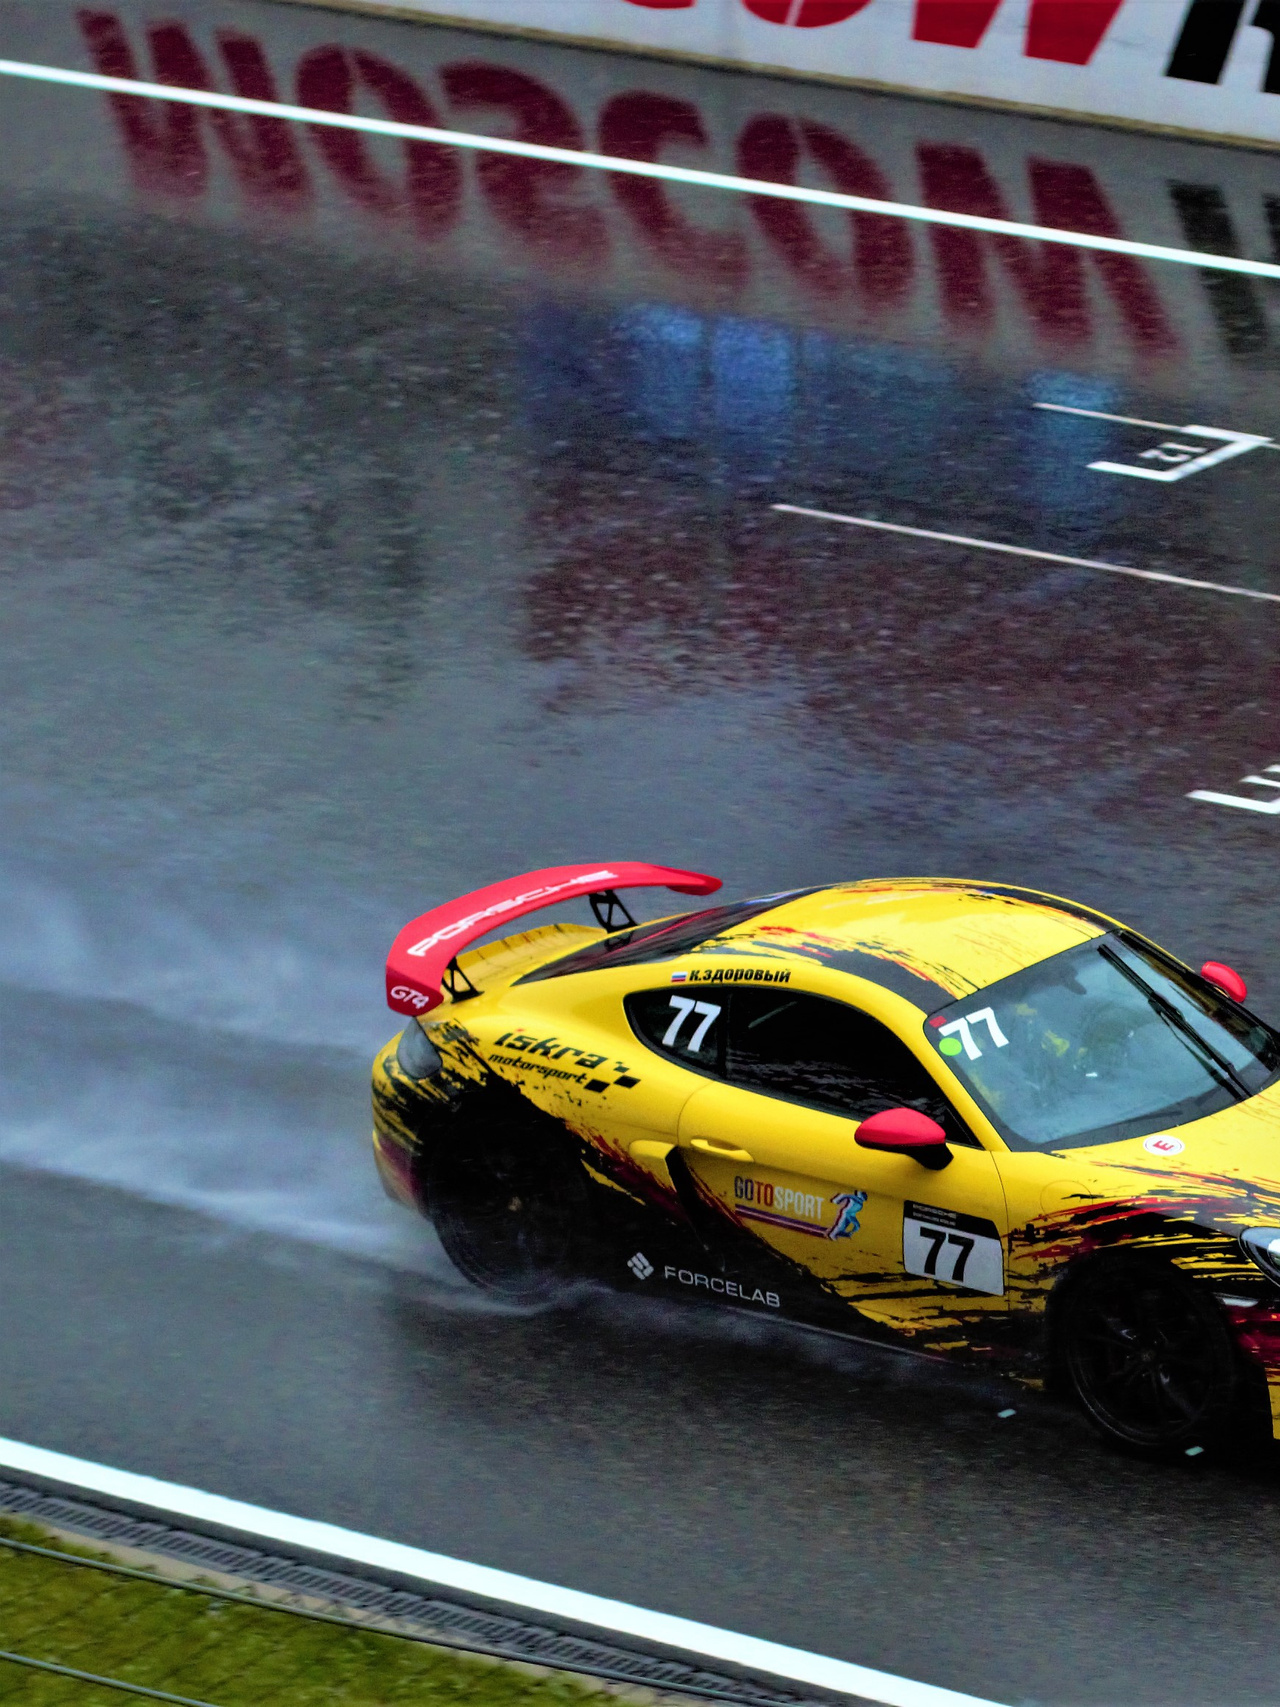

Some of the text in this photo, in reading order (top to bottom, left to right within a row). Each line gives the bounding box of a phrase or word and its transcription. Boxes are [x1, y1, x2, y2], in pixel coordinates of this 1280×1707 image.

[406, 870, 619, 957] PORSCHE
[391, 985, 430, 1009] GT4
[662, 994, 722, 1053] 77
[938, 1006, 1010, 1061] 77
[488, 1053, 588, 1085] motorsport
[493, 1028, 609, 1070] iskra
[1152, 1140, 1175, 1151] E
[734, 1175, 825, 1220] GOTOSPORT
[919, 1226, 975, 1283] 77
[664, 1265, 781, 1308] FORCELAB
